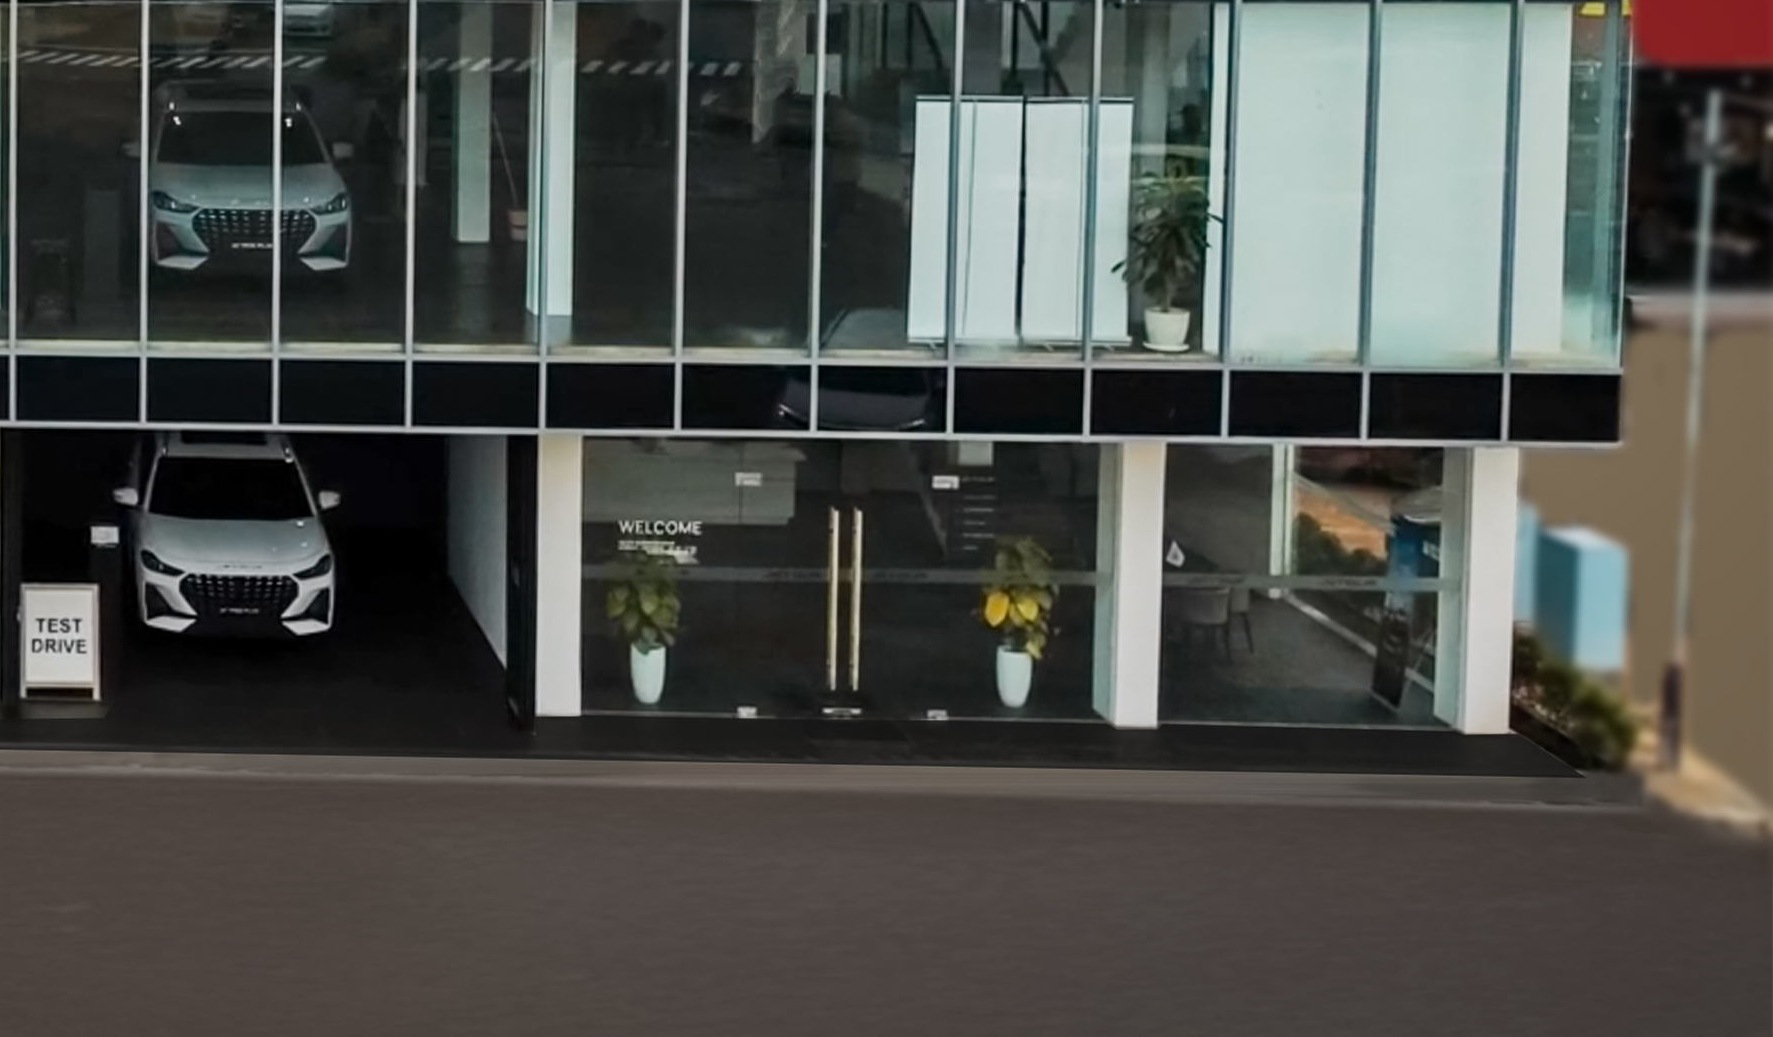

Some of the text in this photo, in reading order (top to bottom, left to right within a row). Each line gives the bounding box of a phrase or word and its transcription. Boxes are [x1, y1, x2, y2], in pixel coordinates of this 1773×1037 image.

[618, 519, 703, 535] WELCOME
[35, 617, 83, 634] TEST
[31, 637, 88, 654] DRIVE
